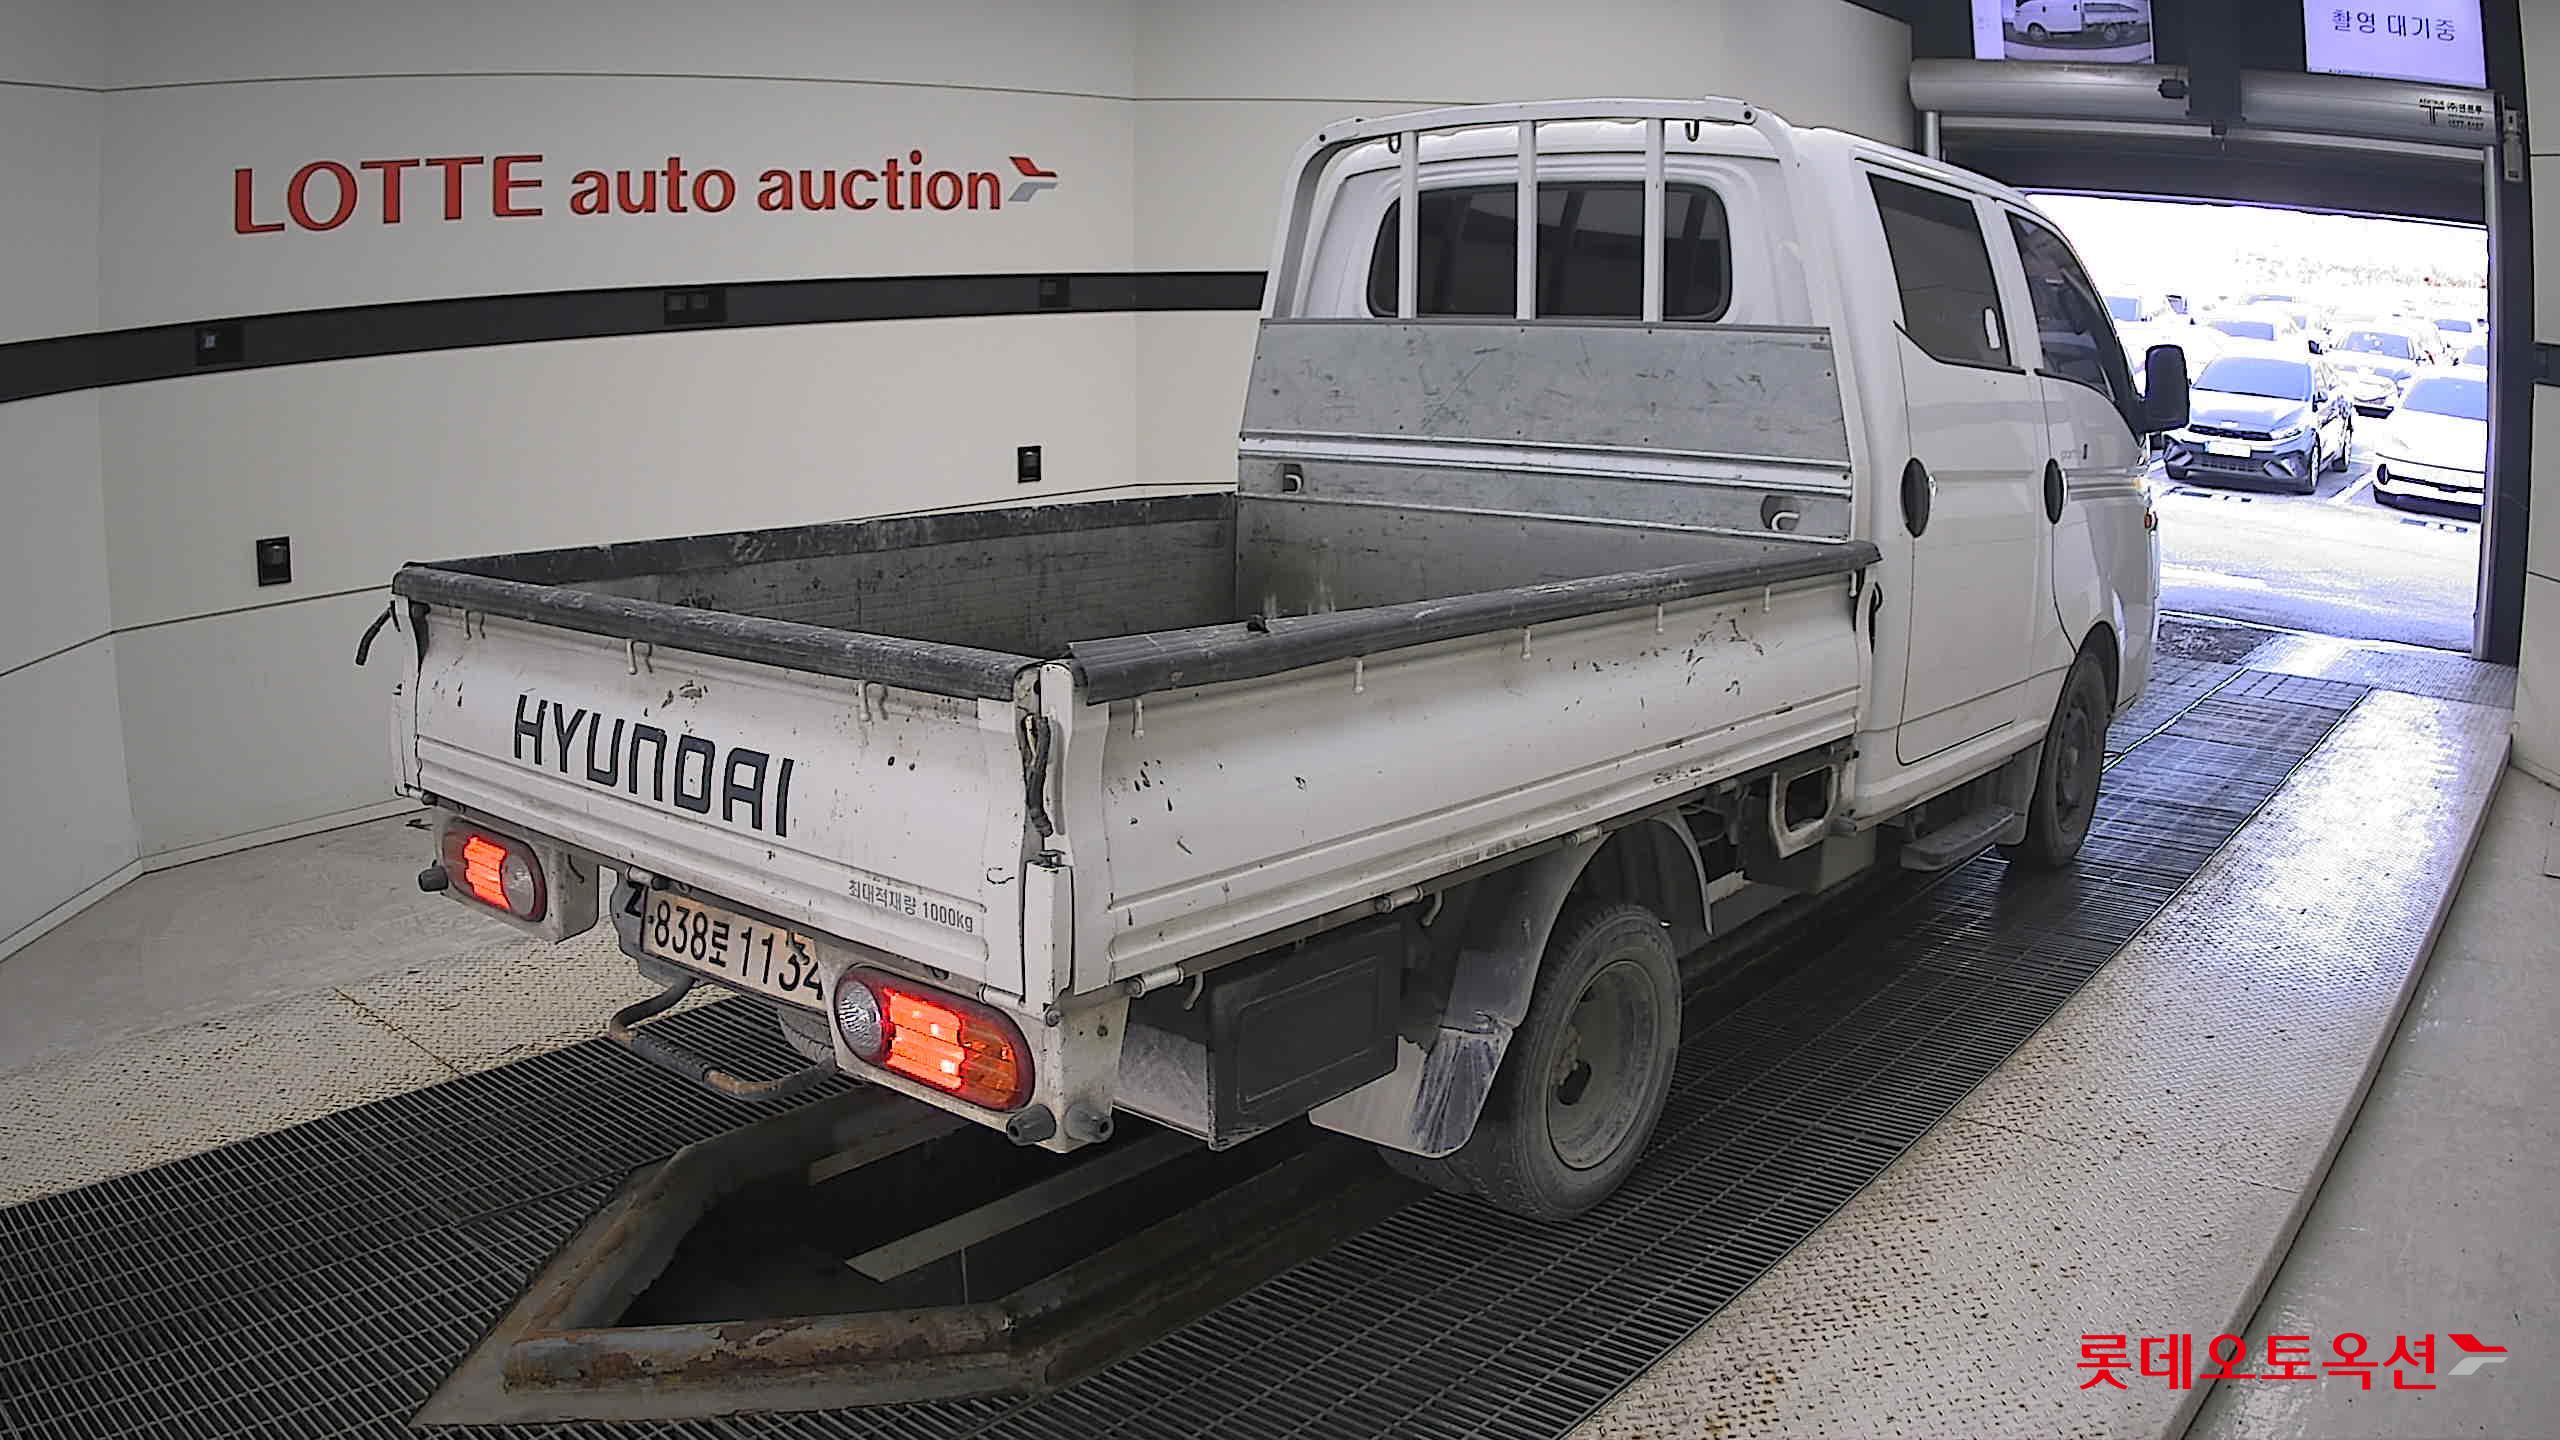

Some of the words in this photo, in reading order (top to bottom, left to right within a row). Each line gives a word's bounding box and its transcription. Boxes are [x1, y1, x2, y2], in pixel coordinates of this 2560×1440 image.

[2332, 9, 2375, 34] 촬영
[2387, 15, 2456, 42] 대기중
[234, 153, 543, 235] LOTTE
[569, 156, 736, 216] auto
[756, 149, 1001, 212] auction
[513, 693, 795, 838] HYUNDAI
[654, 899, 730, 968] 838로
[848, 879, 917, 917] 최대적재량
[922, 900, 974, 933] 1000kg
